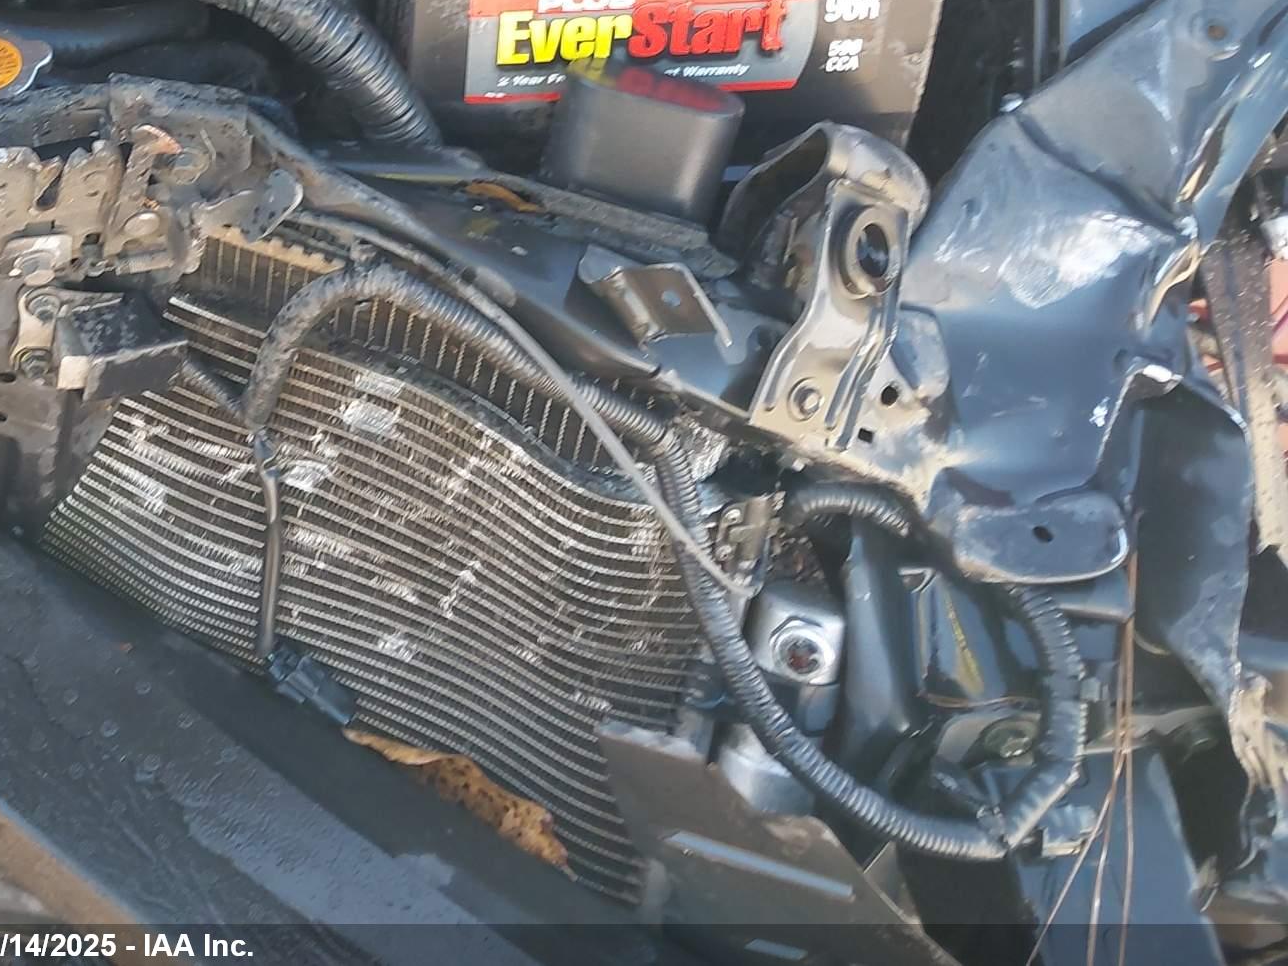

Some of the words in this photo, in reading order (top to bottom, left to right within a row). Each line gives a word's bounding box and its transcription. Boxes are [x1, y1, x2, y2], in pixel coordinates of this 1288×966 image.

[825, 55, 859, 72] CCA
[512, 74, 547, 86] Year
[683, 63, 750, 77] Warranty
